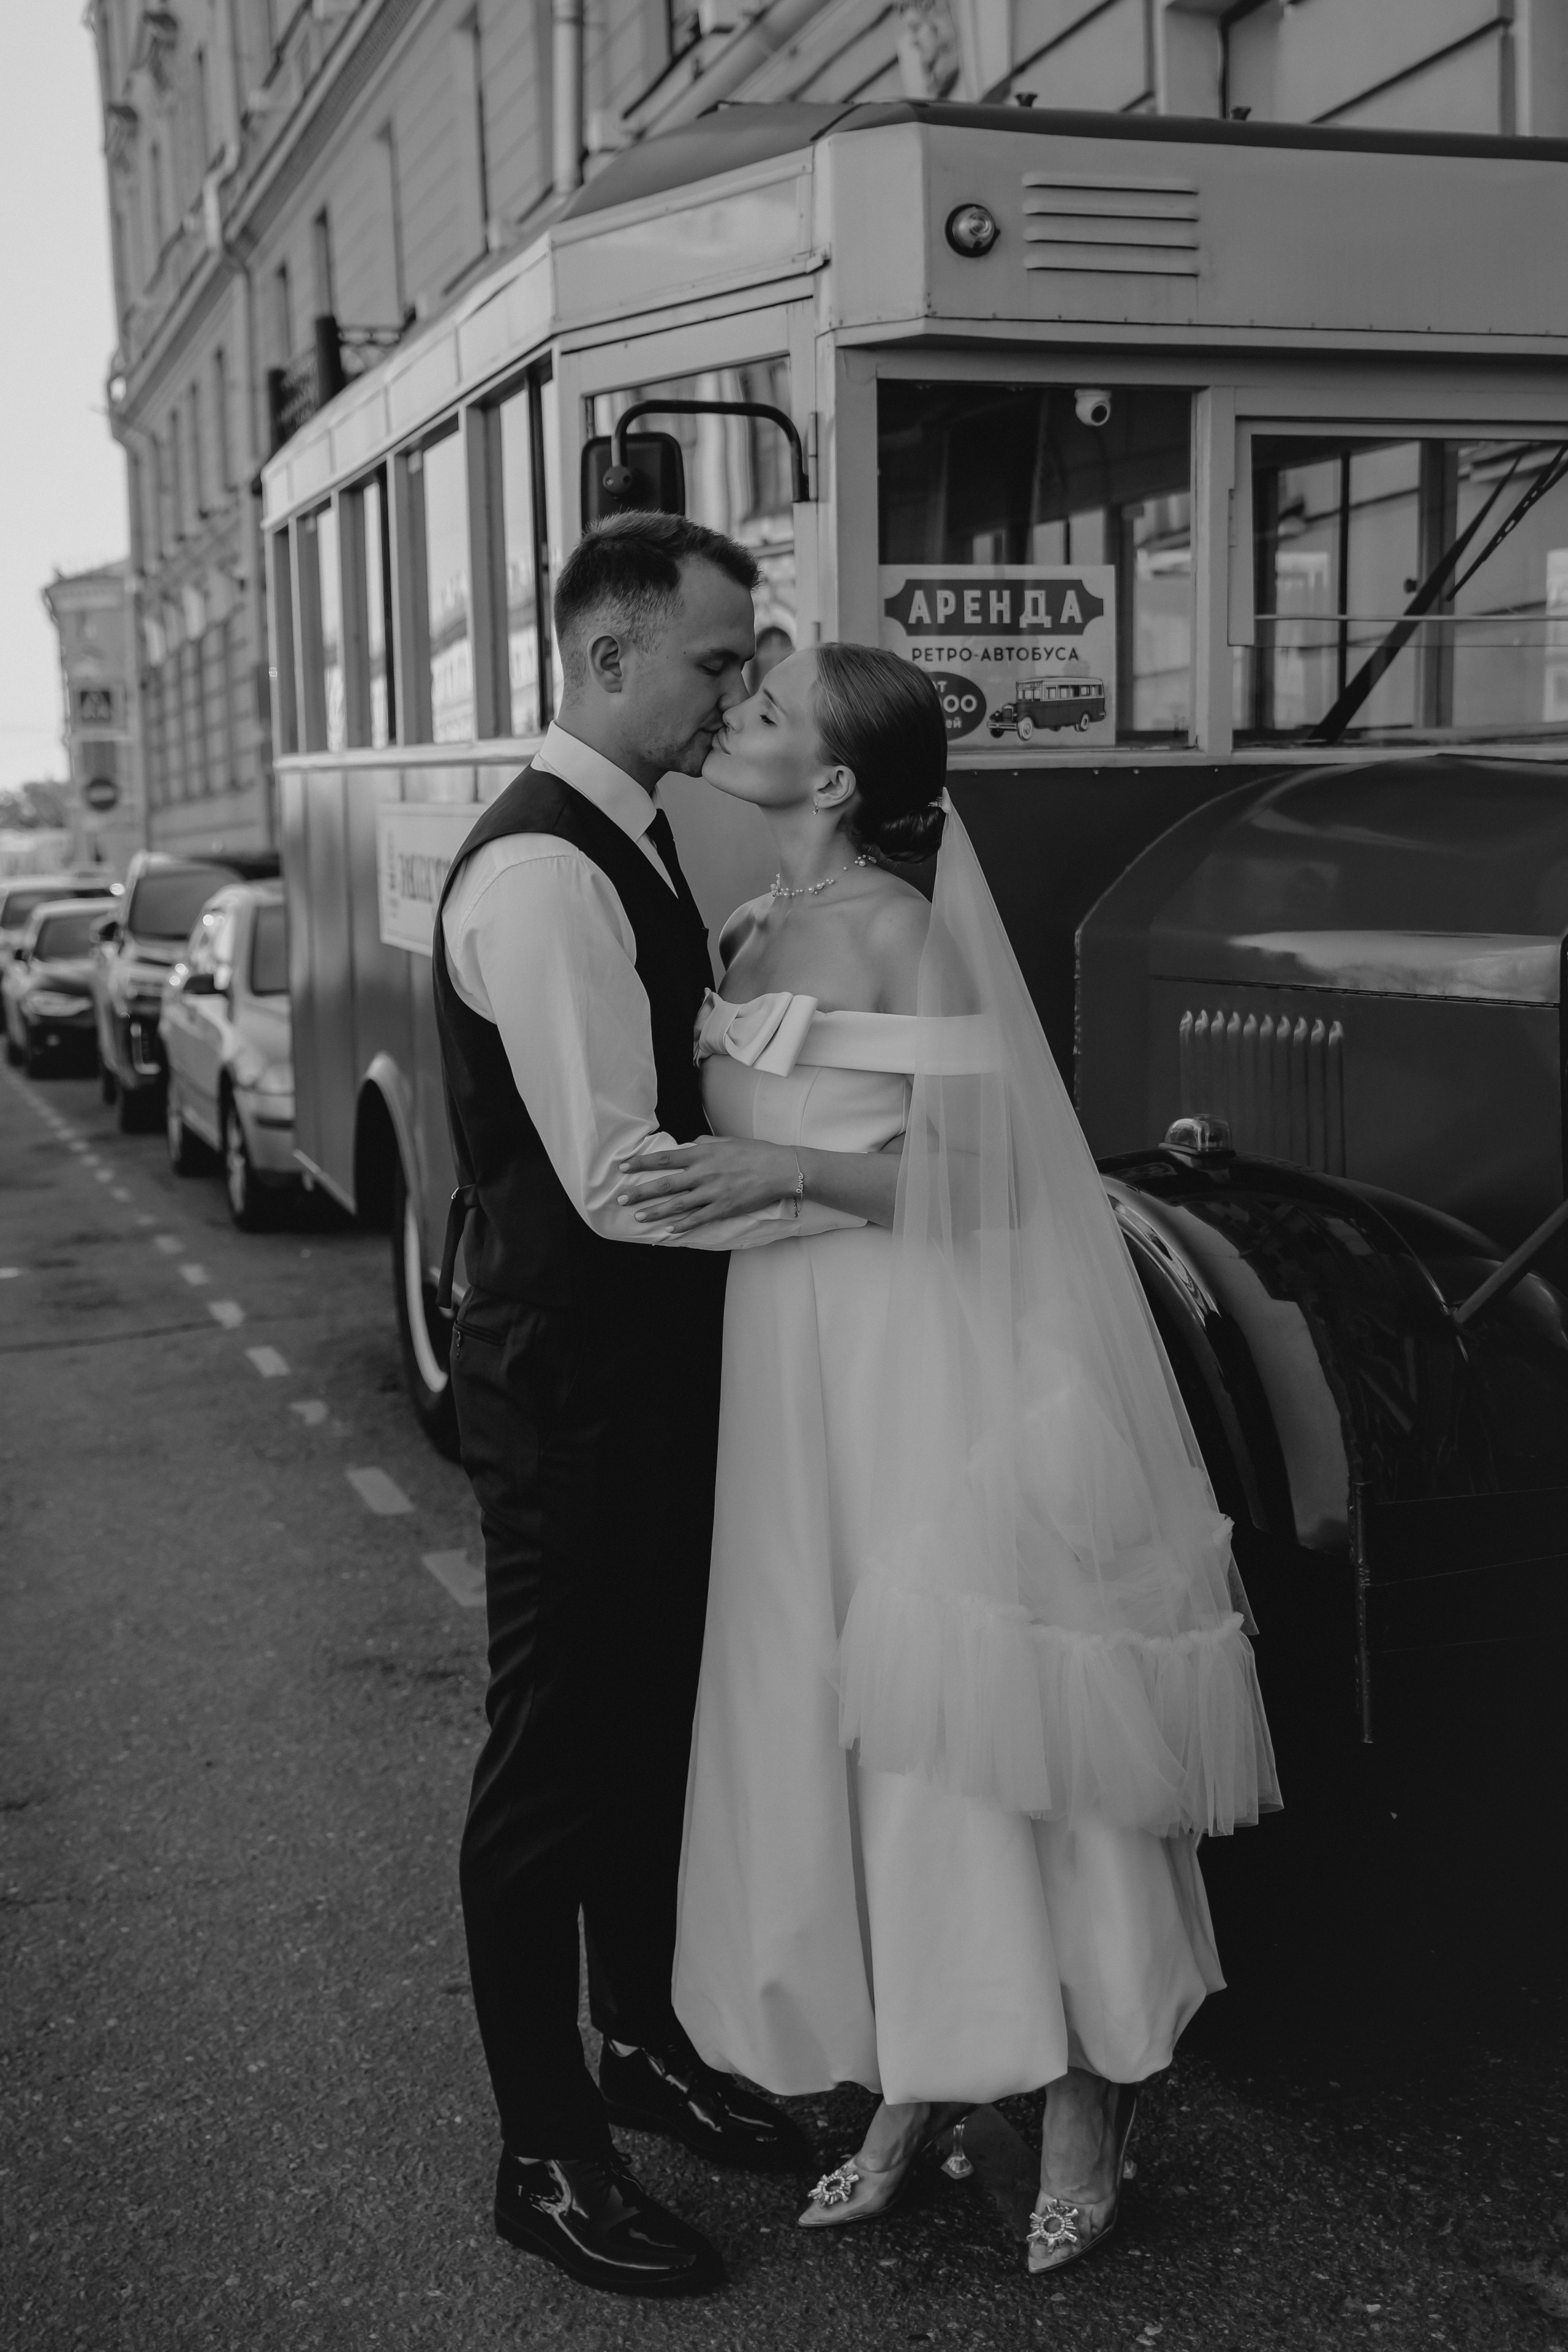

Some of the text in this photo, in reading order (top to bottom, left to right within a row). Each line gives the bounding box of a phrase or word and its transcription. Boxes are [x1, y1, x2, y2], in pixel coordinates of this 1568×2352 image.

[908, 589, 1084, 628] АРЕНДА
[911, 647, 1079, 662] РЕТРО-АВТОБУСА
[938, 695, 977, 713] 00
[945, 717, 962, 729] ей
